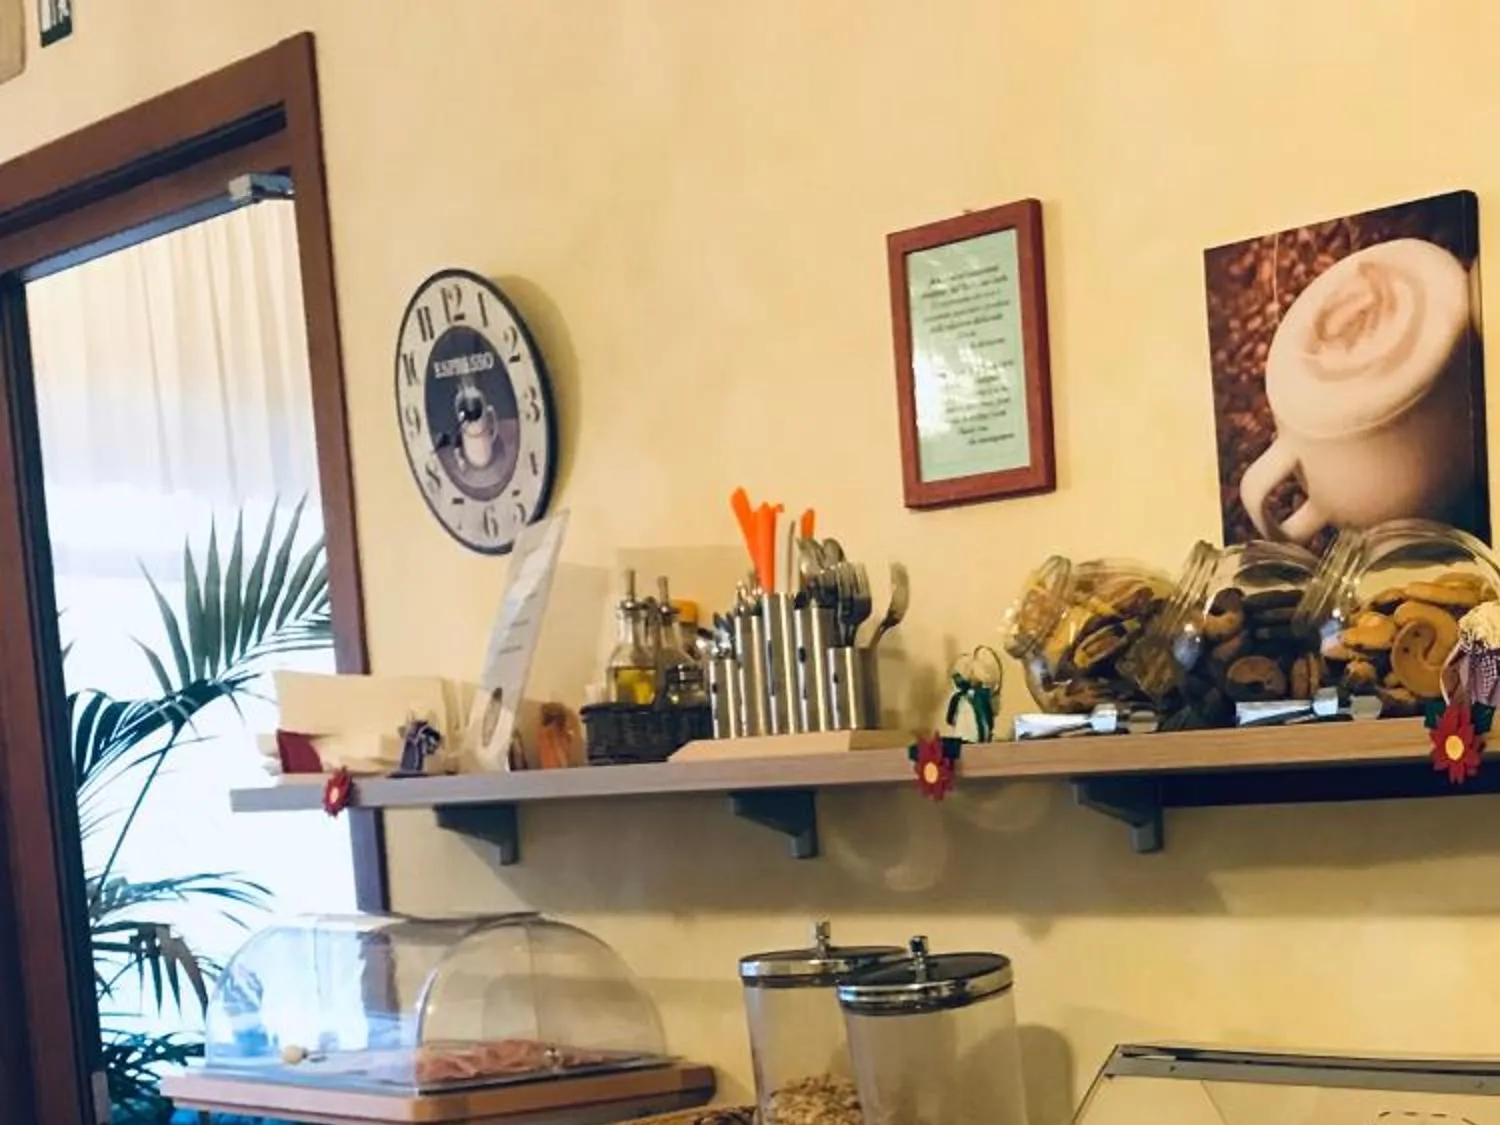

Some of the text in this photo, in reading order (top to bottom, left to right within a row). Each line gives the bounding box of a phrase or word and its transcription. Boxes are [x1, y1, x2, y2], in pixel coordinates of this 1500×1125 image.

[441, 285, 466, 324] 12
[416, 306, 435, 342] 11
[503, 326, 521, 362] 2
[404, 405, 421, 437] 9
[524, 386, 542, 423] 3
[424, 459, 442, 493] 8
[482, 503, 500, 539] 6
